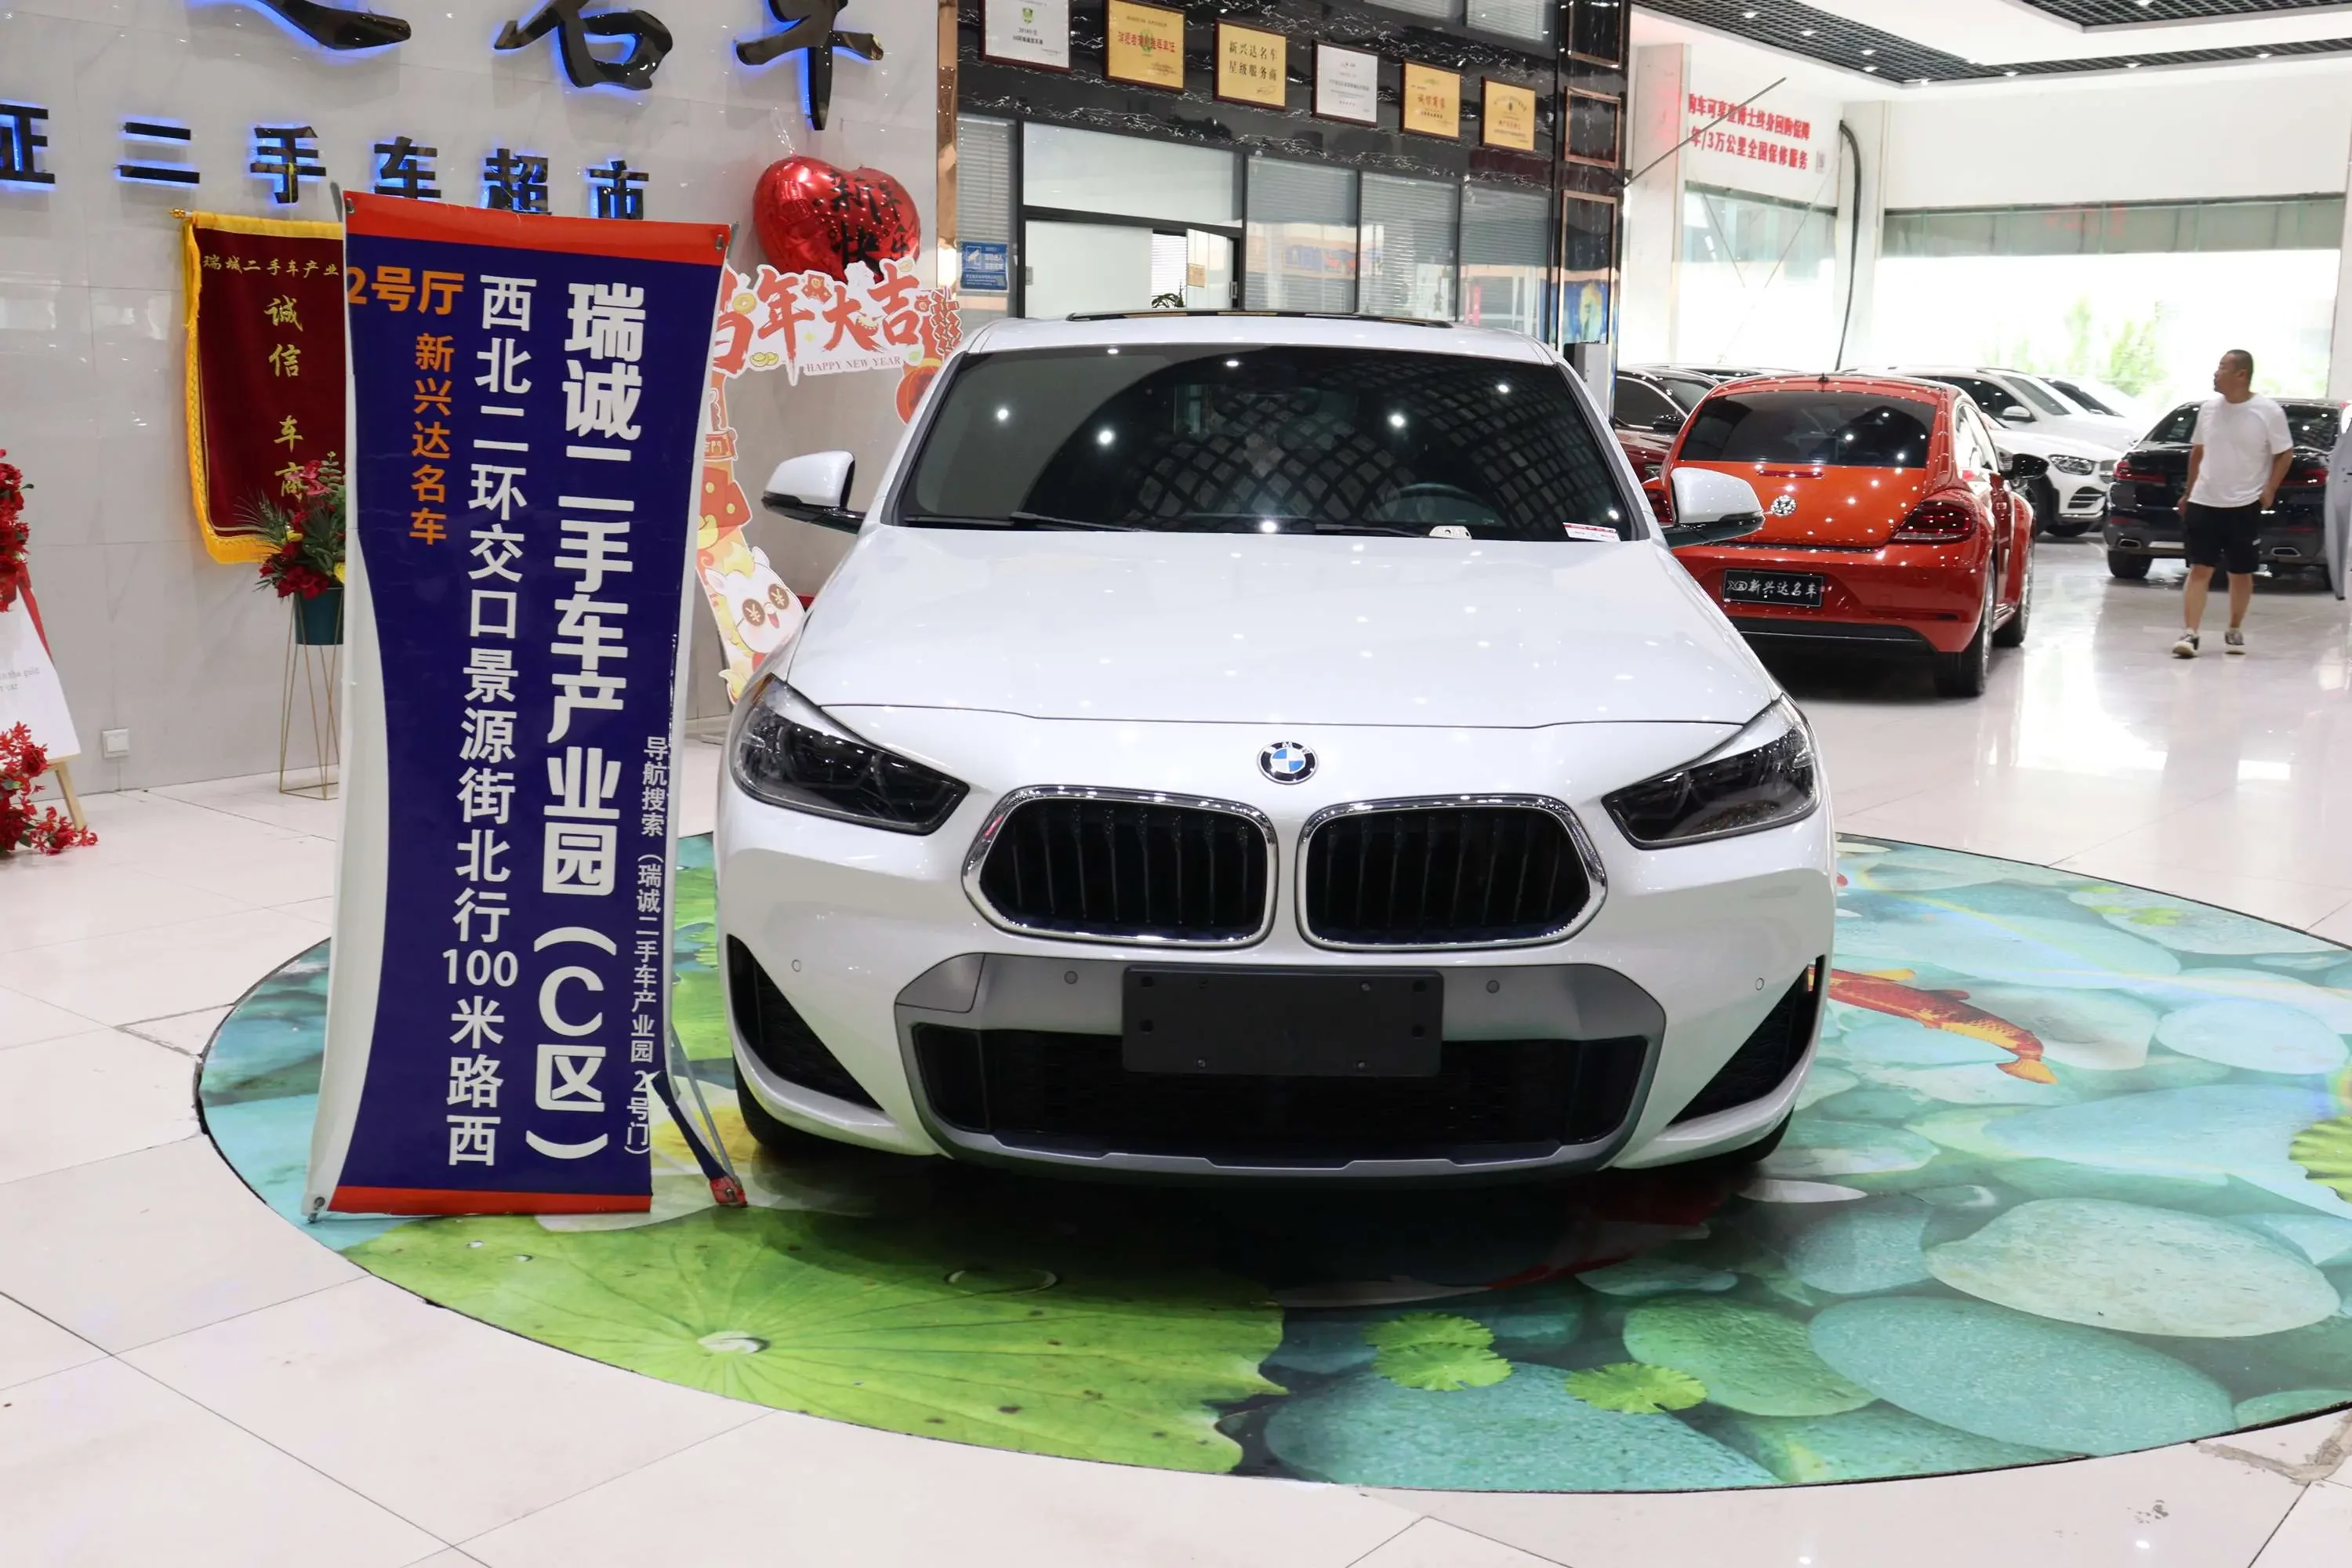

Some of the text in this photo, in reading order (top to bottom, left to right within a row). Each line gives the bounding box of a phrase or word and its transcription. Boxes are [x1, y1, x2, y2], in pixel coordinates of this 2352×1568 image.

[1229, 40, 1278, 62] 新兴达名车
[1229, 60, 1277, 82] 星级服务商
[348, 265, 465, 316] 2号厅
[806, 355, 902, 372] HAPPY NEW YEAR
[409, 332, 456, 546] 新兴达名车
[1748, 579, 1817, 600] 新兴达名车
[443, 274, 538, 1167] 西北二环交口景源街北行100米路西
[641, 735, 669, 837] 导航搜索
